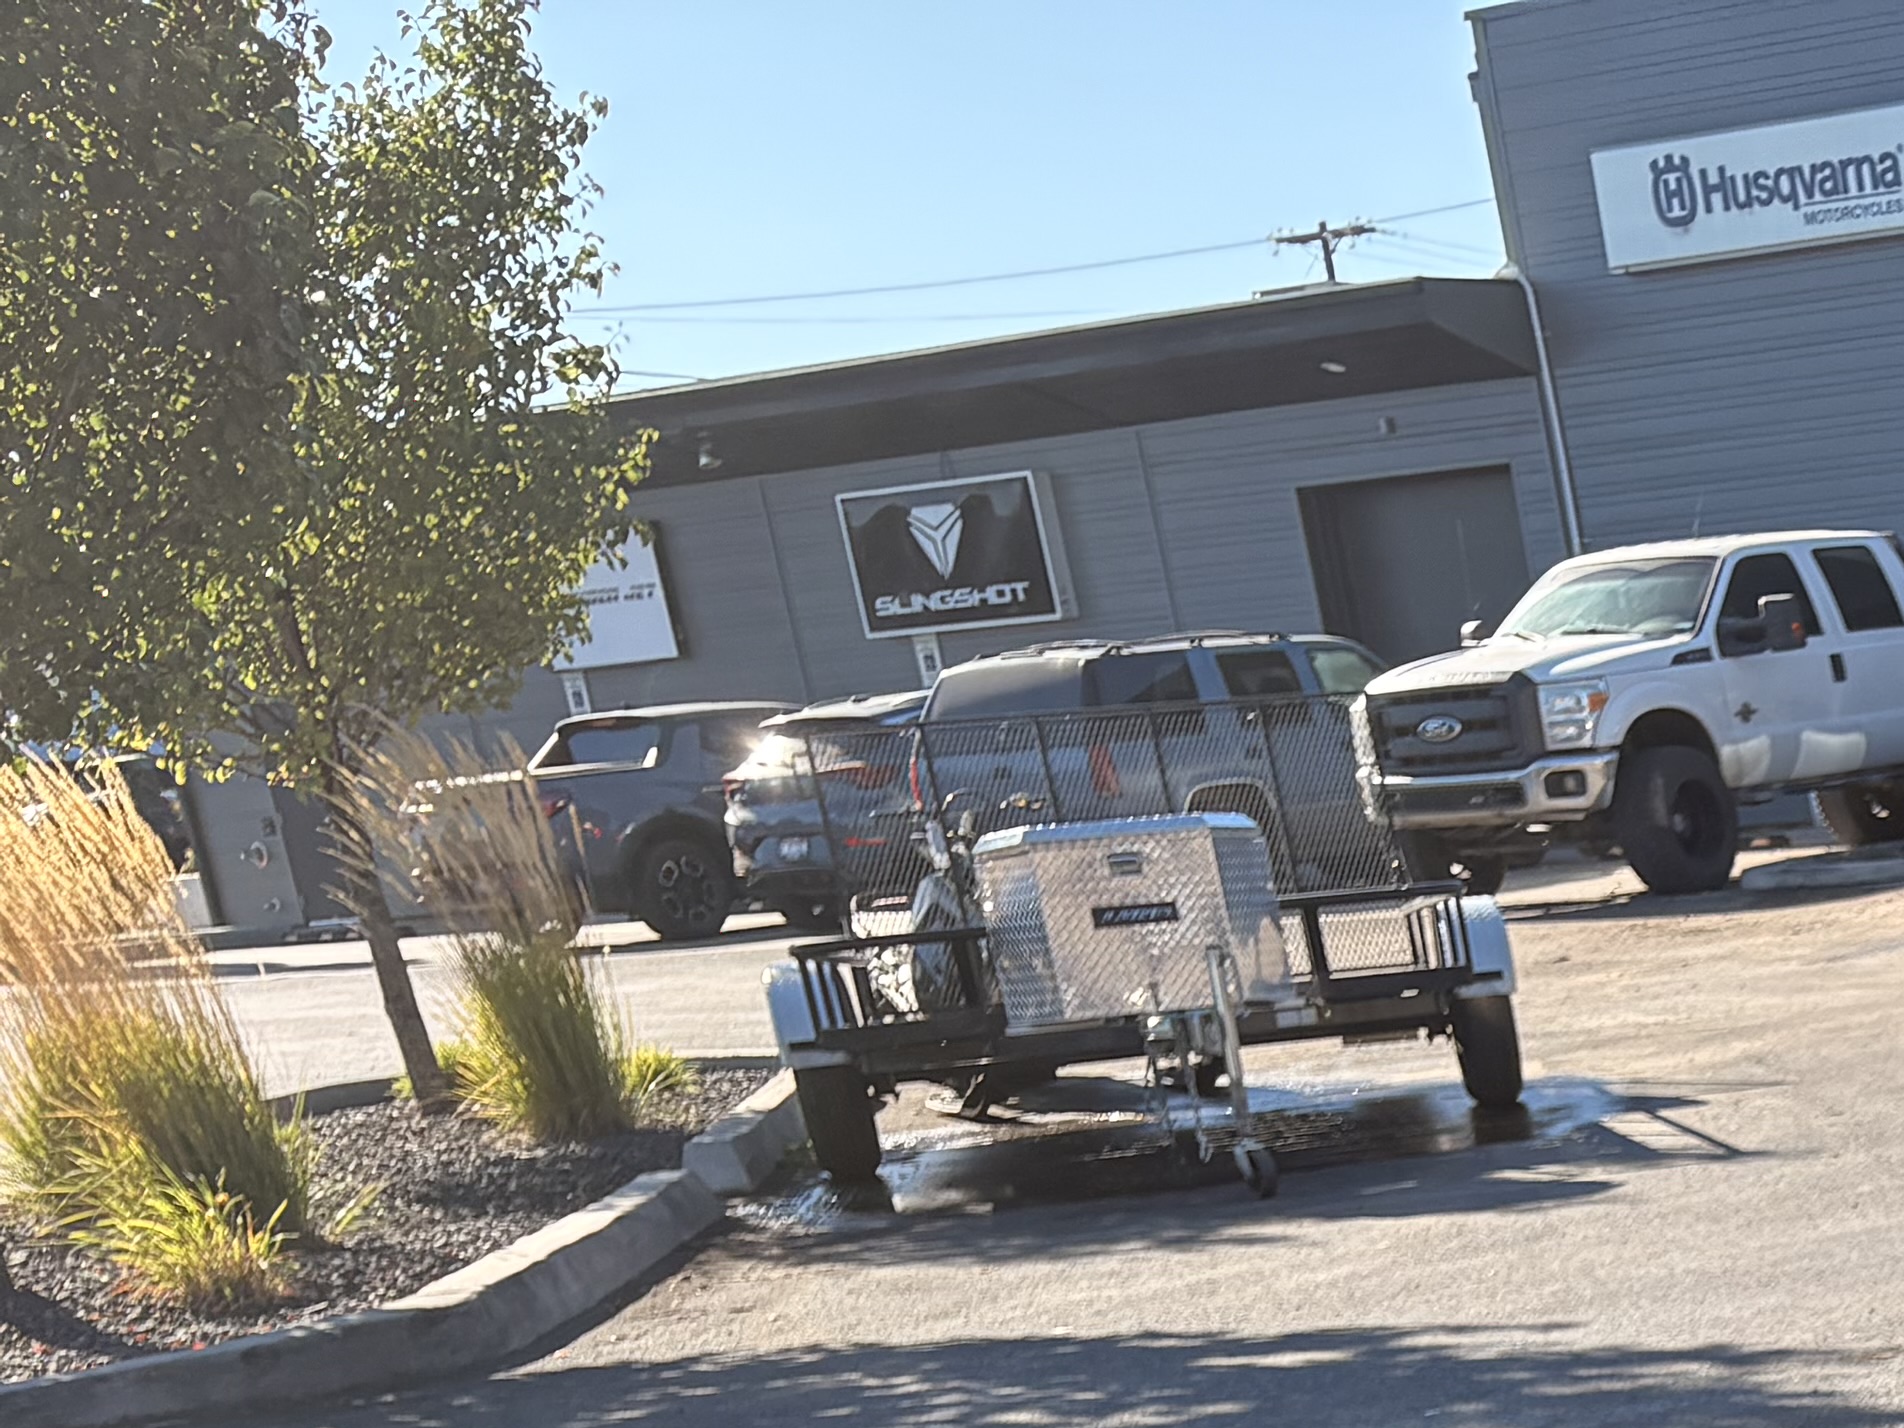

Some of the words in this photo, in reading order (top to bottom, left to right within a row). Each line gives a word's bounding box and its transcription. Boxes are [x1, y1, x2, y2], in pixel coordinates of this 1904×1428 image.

[1698, 151, 1903, 213] Husqvarna
[1803, 198, 1904, 225] MOTORCYCLES
[875, 581, 1030, 617] SLINGSHOT
